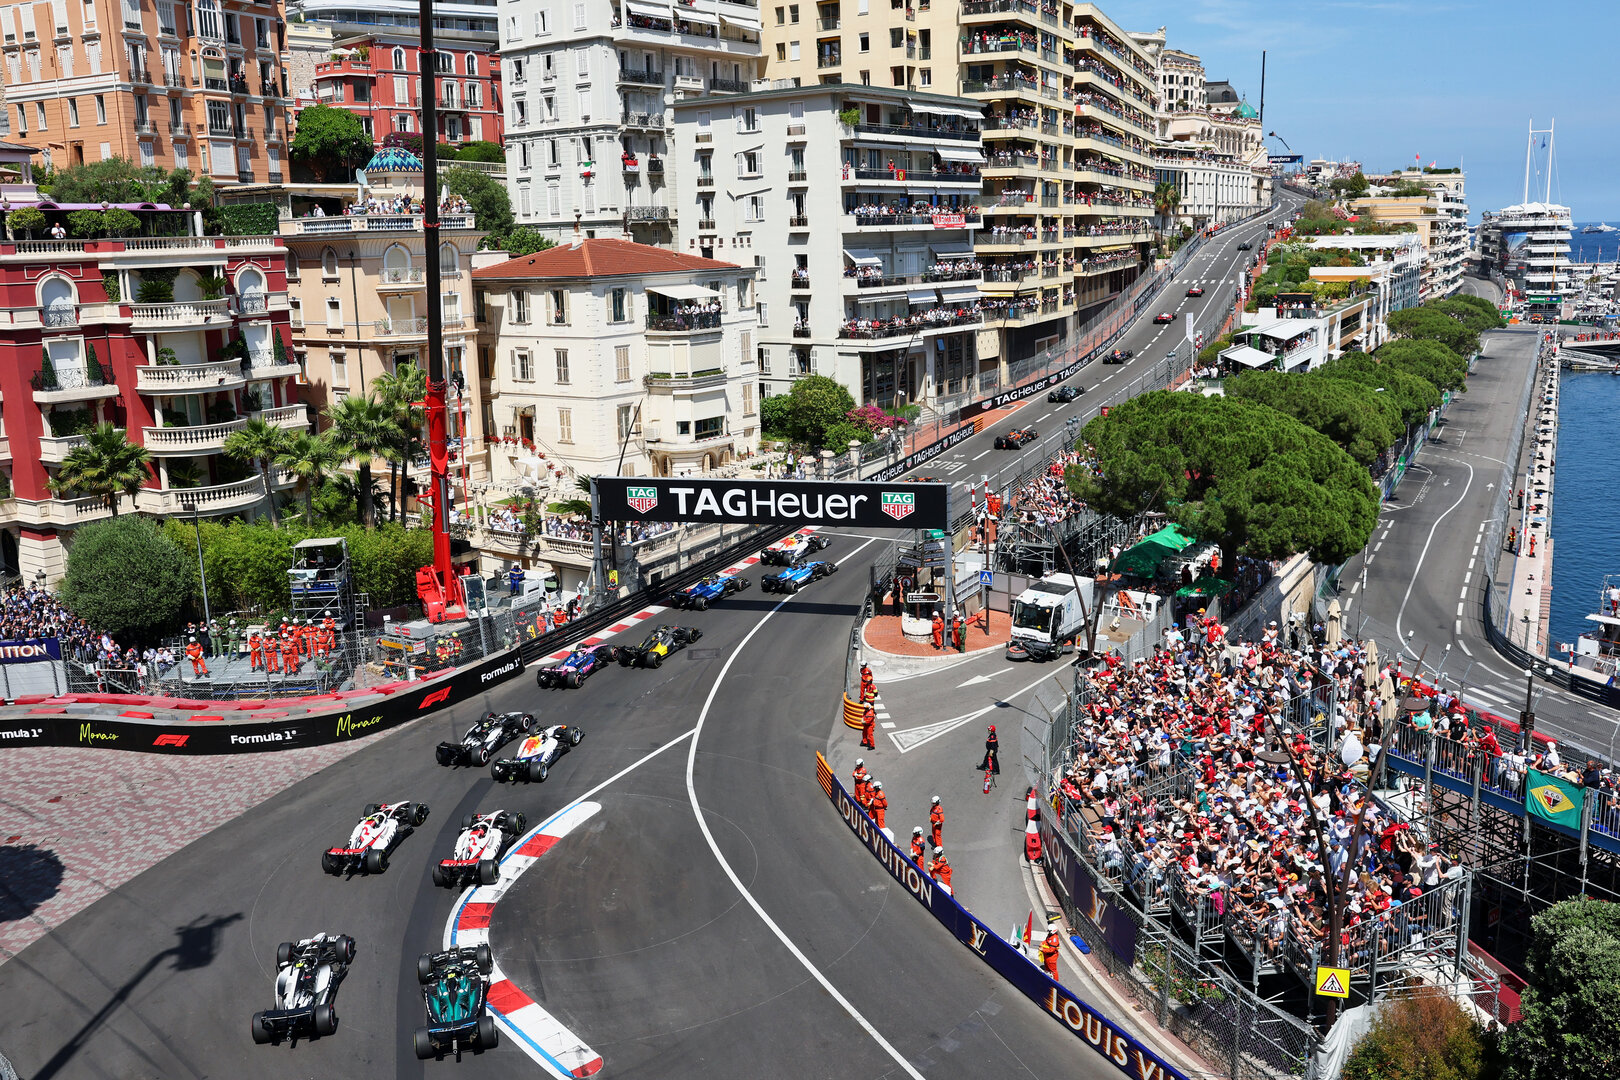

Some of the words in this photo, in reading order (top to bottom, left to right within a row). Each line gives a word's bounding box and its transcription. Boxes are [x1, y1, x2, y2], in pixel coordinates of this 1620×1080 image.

[630, 488, 654, 497] TAG
[884, 494, 912, 502] TAG
[630, 499, 656, 510] HEUER
[884, 504, 912, 518] HEUER
[481, 661, 514, 682] Formula
[336, 714, 383, 737] Monaco
[230, 732, 282, 744] Formula
[838, 789, 868, 842] LOUIS
[871, 828, 932, 908] VUITTON
[1052, 988, 1128, 1066] LOUIS
